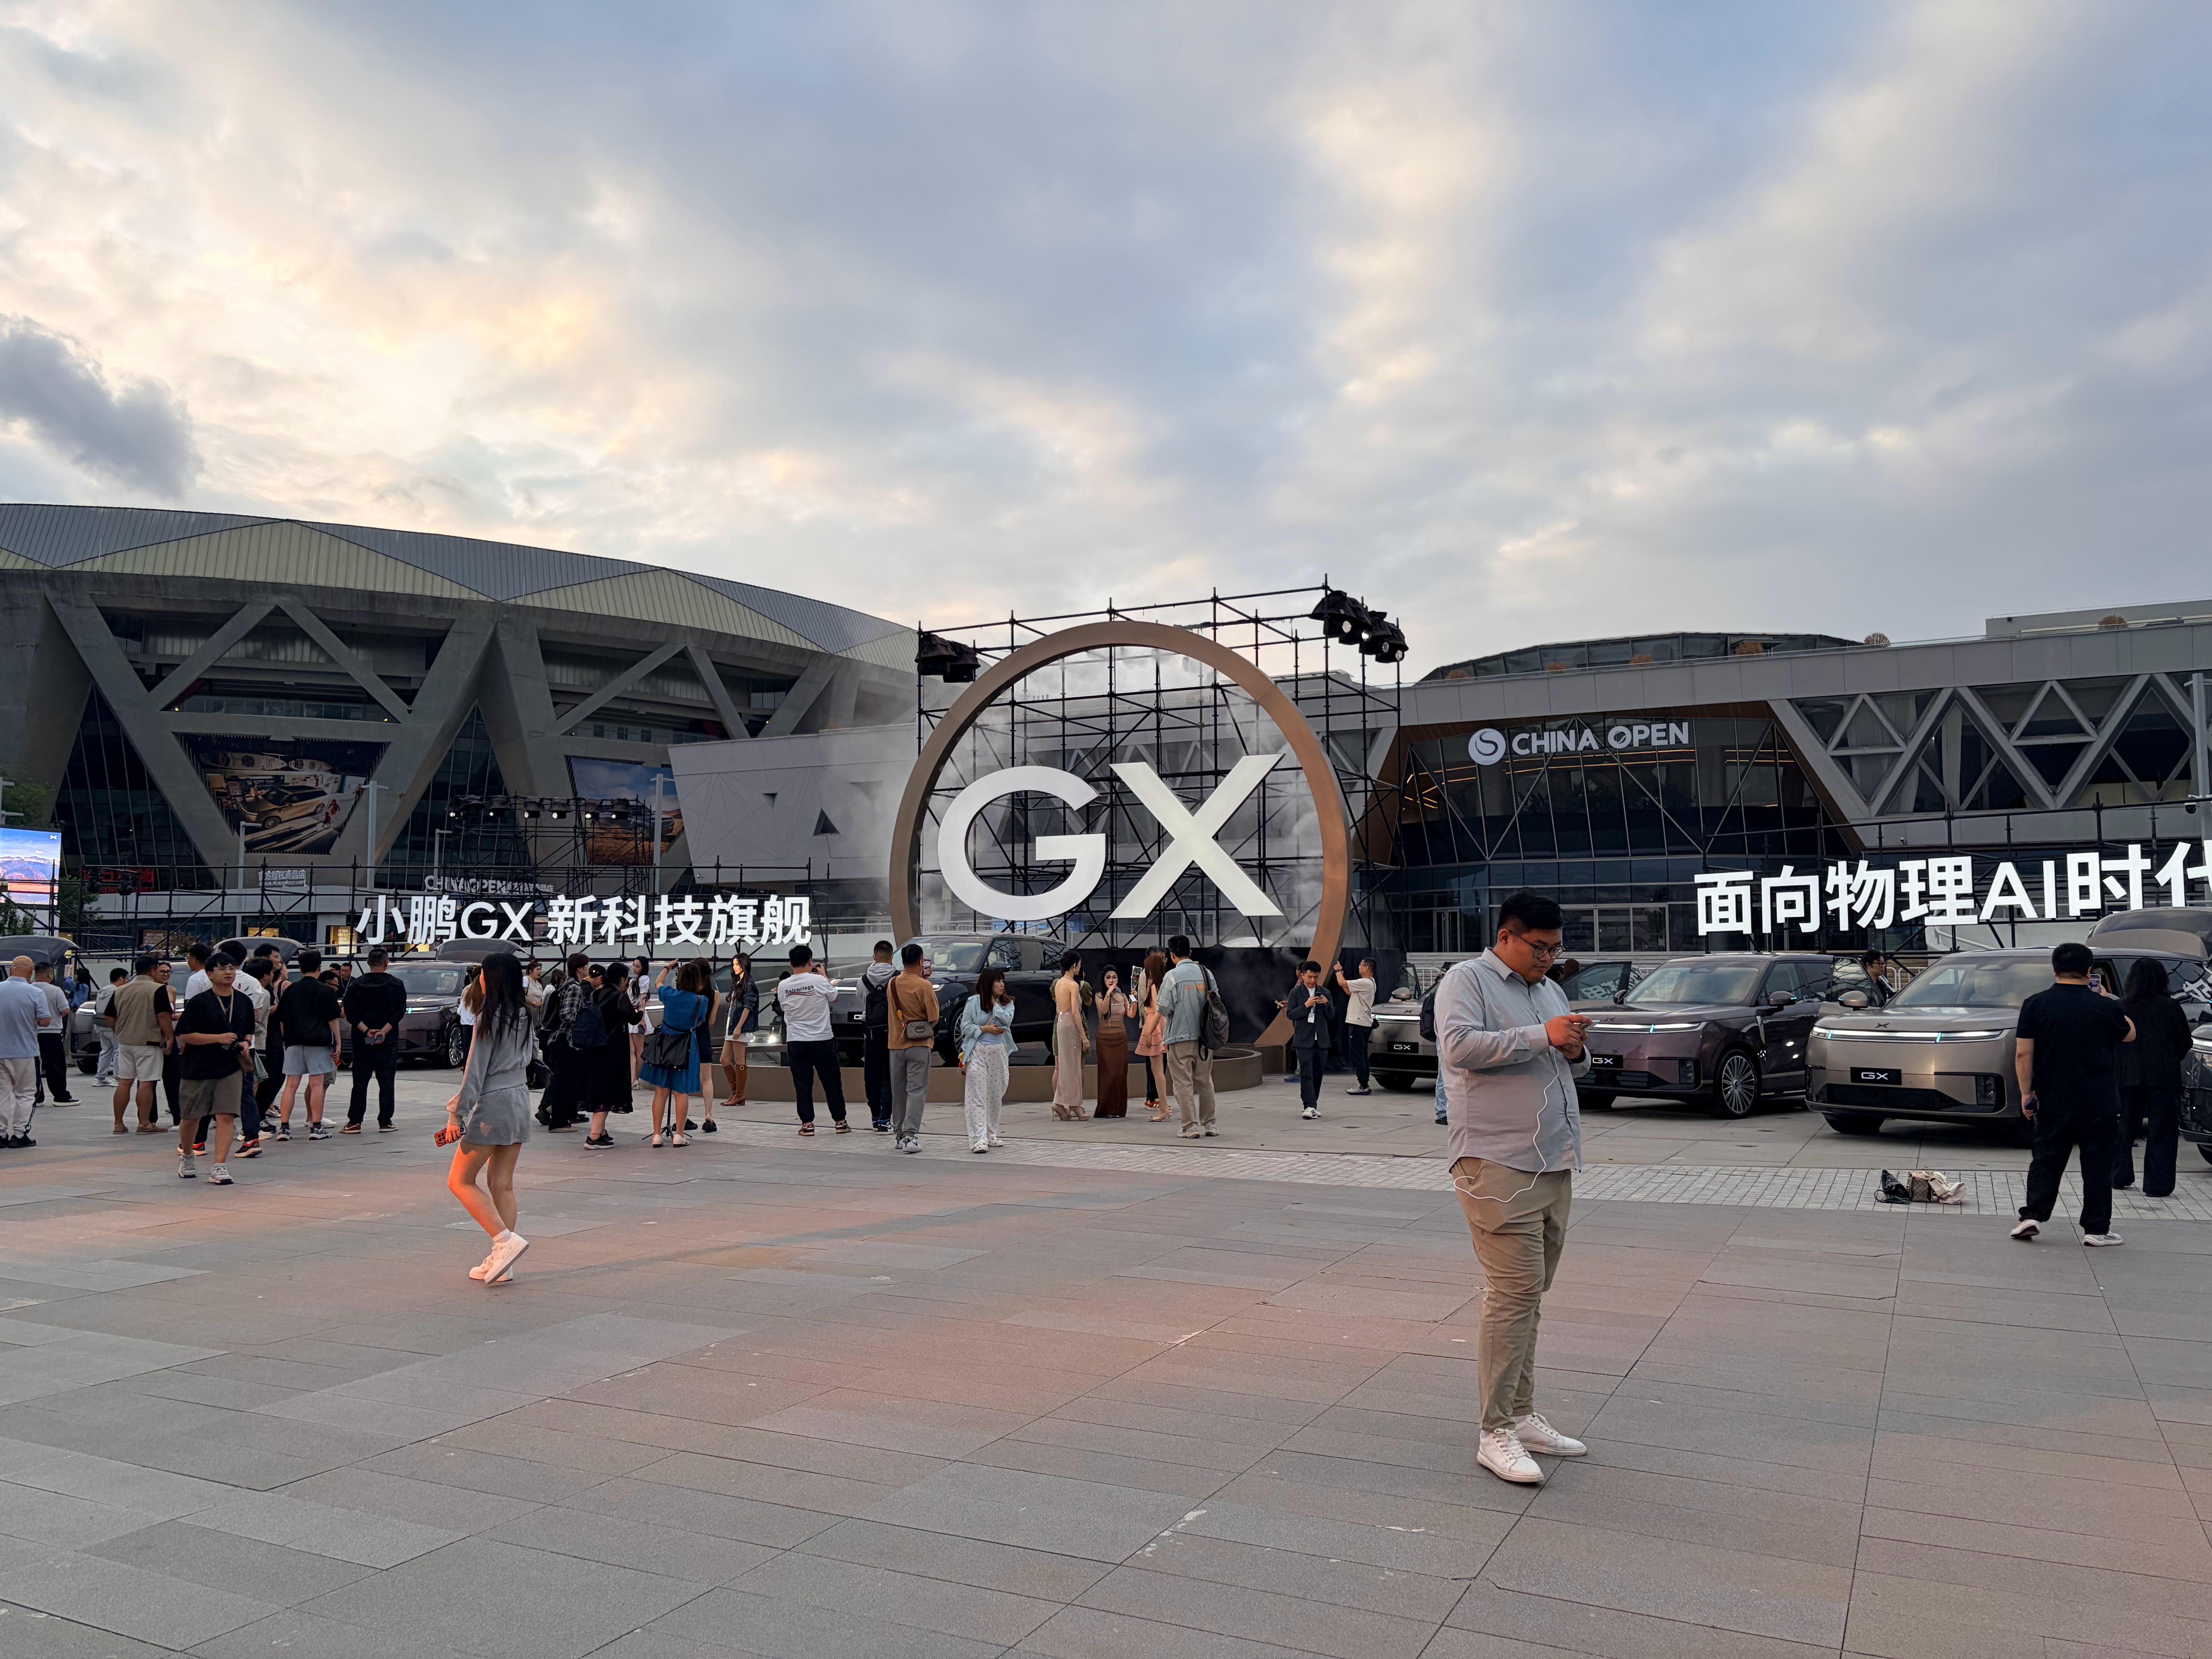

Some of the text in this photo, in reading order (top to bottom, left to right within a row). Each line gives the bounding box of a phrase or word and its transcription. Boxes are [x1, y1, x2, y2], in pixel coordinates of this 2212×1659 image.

[1512, 722, 1688, 755] CHINA OPEN
[938, 754, 1285, 921] GX
[356, 894, 811, 946] 小鹏GX 新科技旗舰
[785, 985, 814, 994] Balenciaga
[1861, 1072, 1889, 1080] GX
